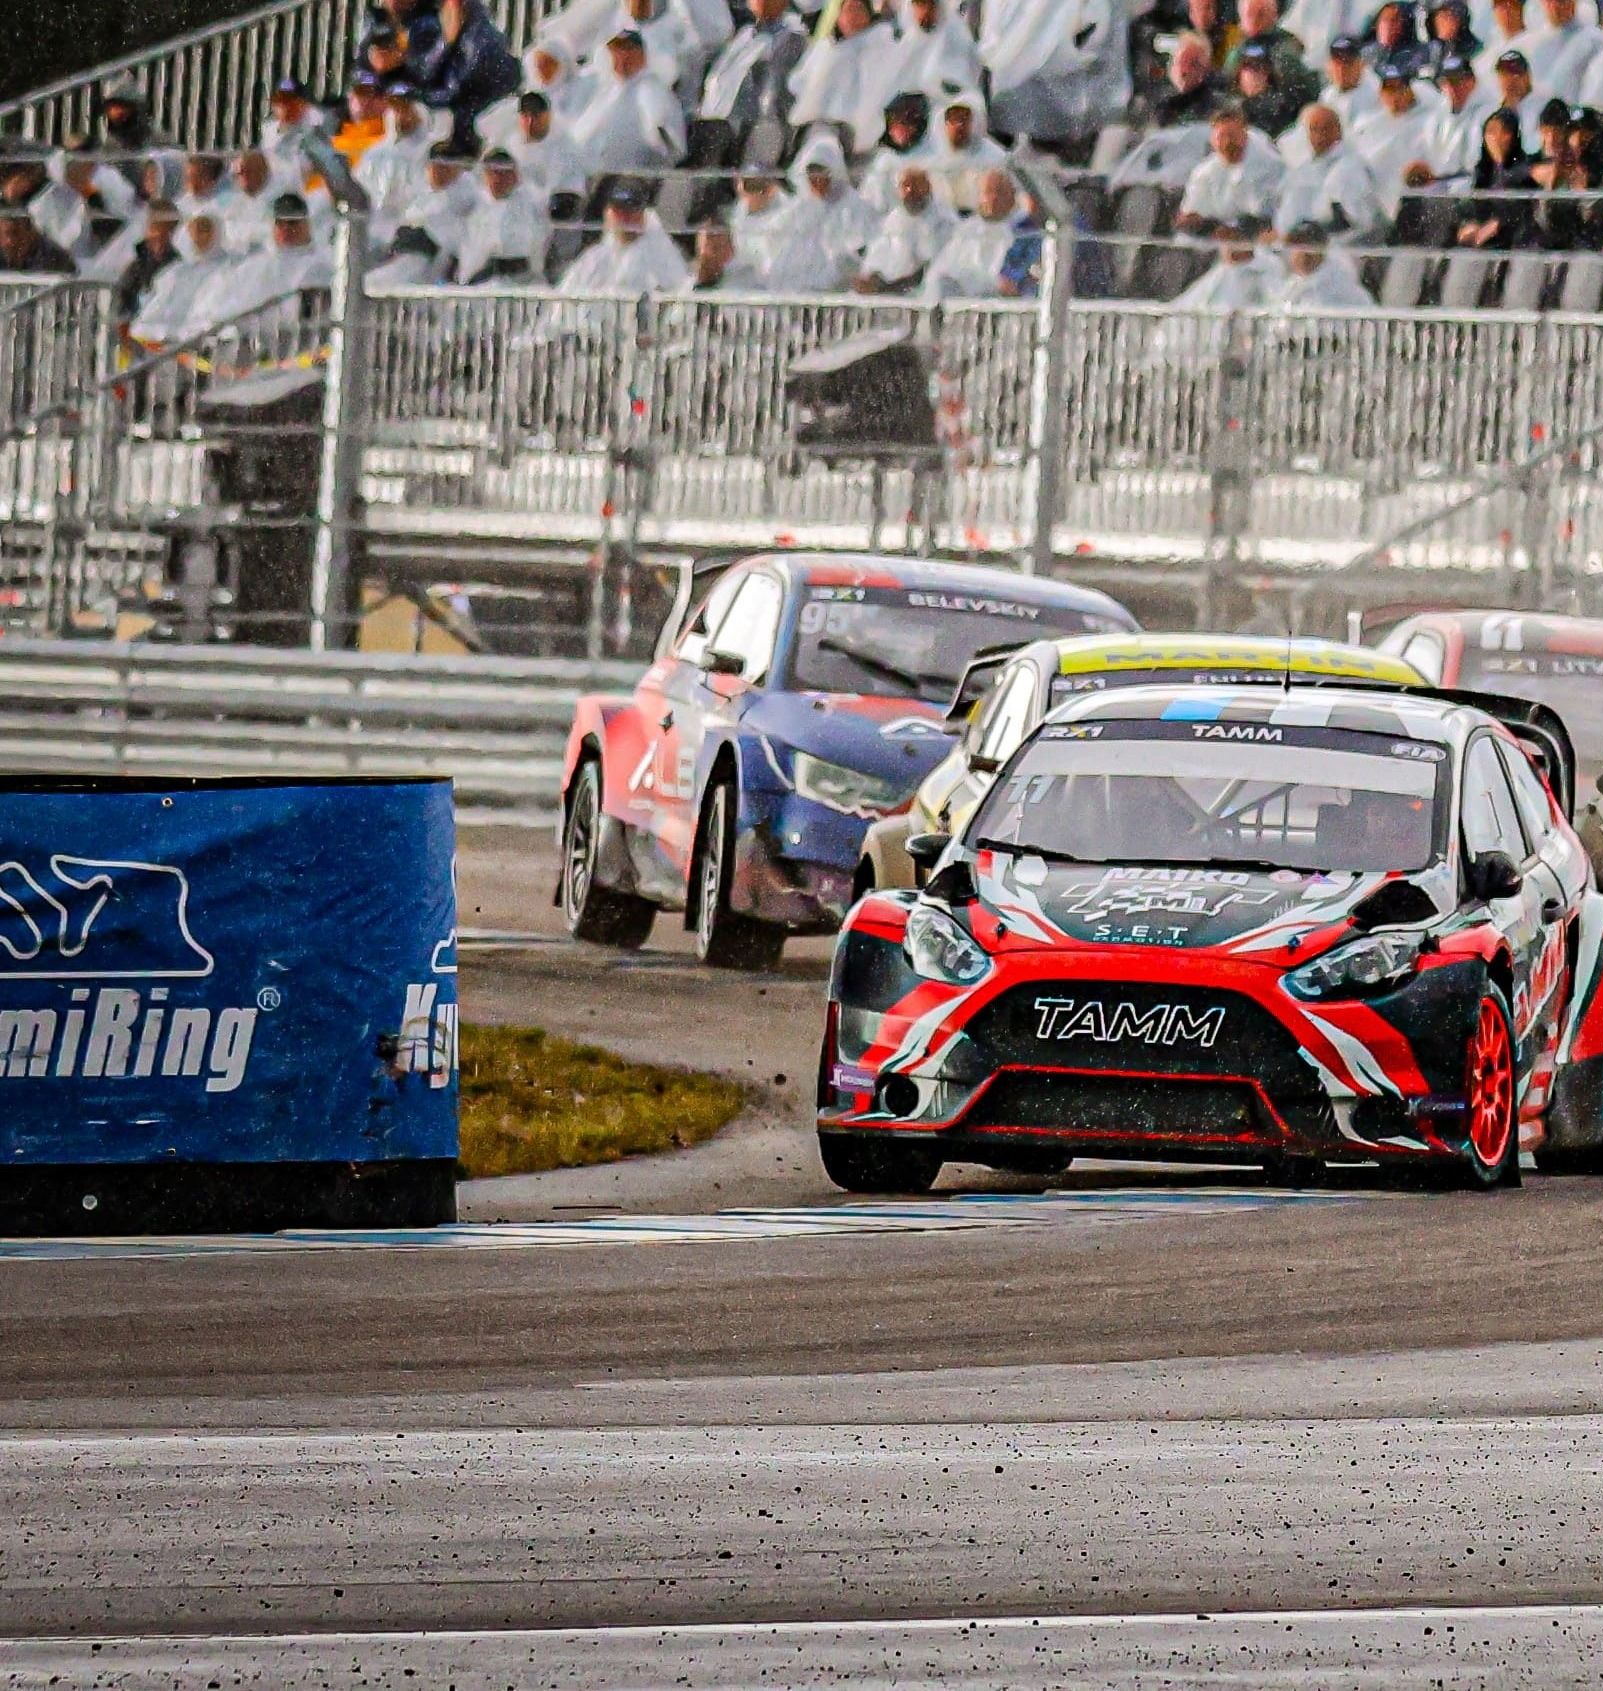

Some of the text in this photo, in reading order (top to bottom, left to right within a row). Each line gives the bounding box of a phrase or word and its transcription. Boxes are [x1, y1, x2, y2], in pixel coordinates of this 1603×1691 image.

[1048, 725, 1104, 739] RX1
[1191, 724, 1284, 742] TAMM
[1034, 997, 1226, 1047] TAMM
